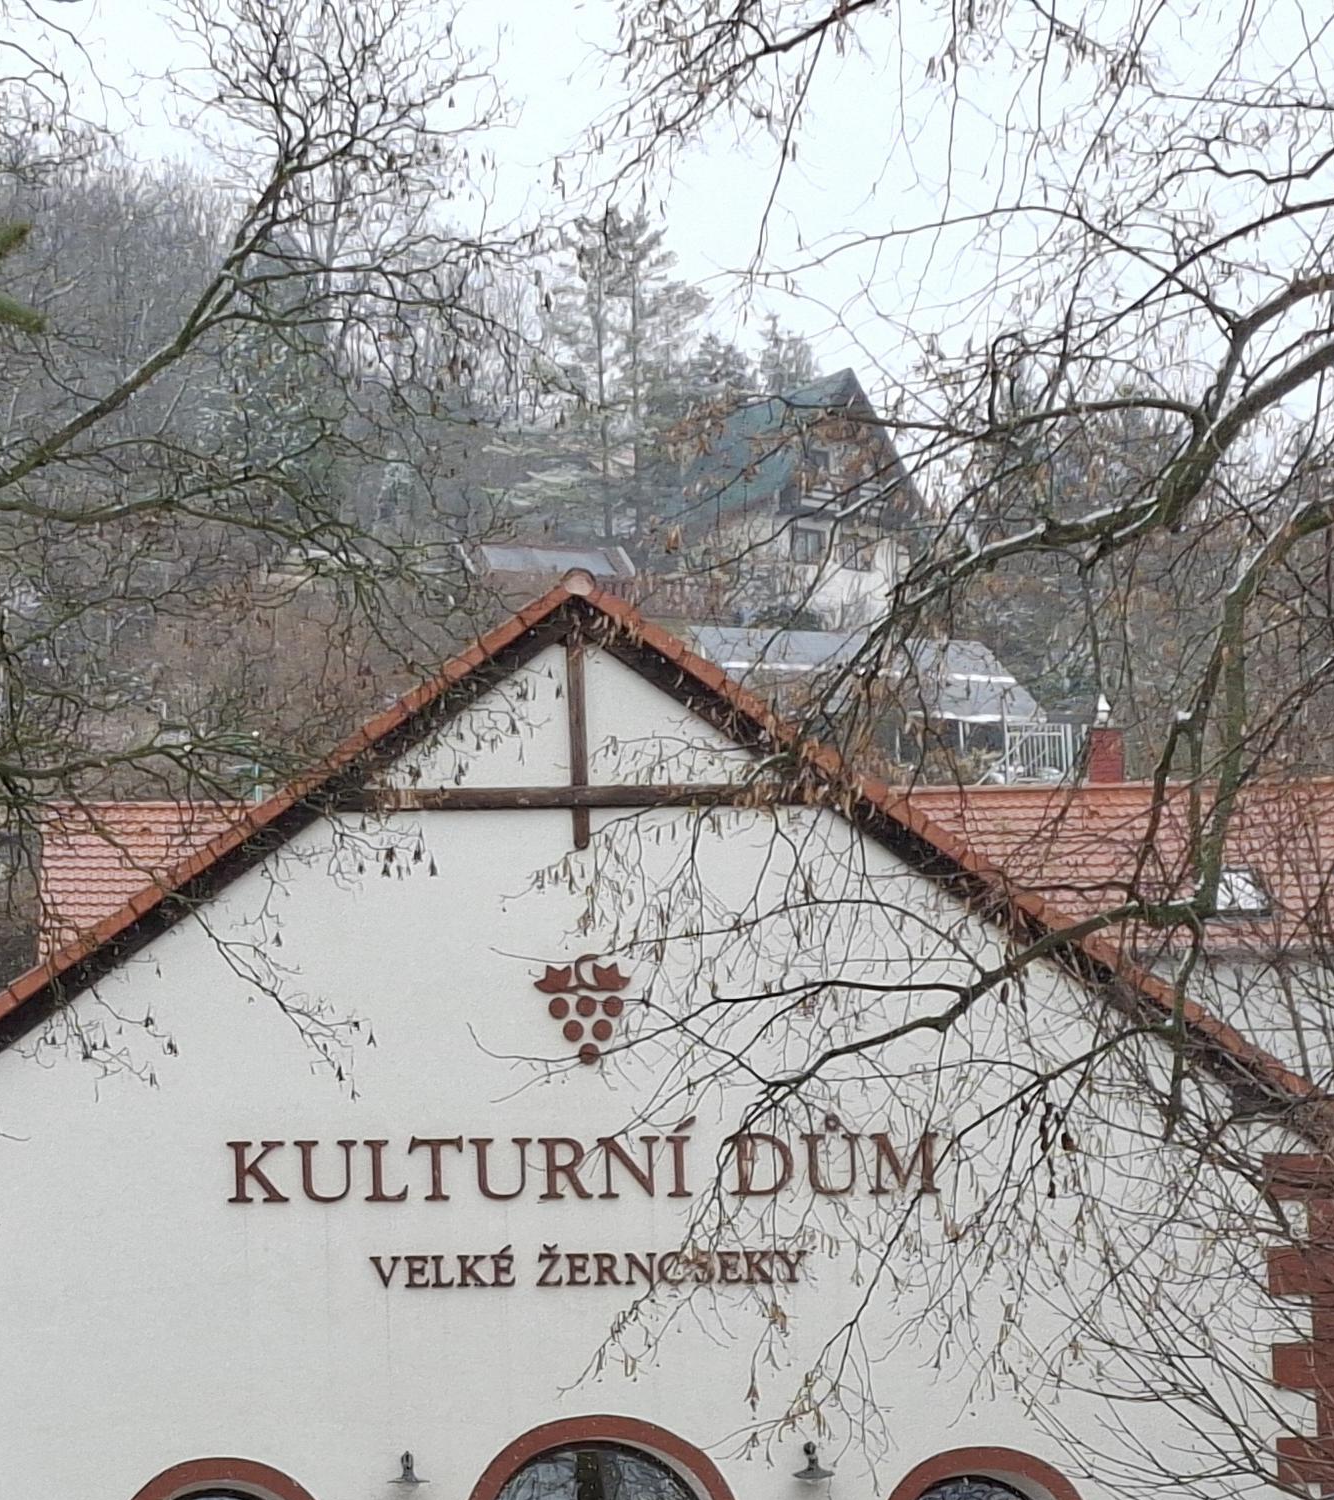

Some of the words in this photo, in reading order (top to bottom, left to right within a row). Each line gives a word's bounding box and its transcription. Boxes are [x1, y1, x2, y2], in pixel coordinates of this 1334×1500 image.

[226, 1115, 696, 1203] KULTURNÍ
[729, 1113, 942, 1196] DŮM
[369, 1244, 516, 1288] VELKÉ
